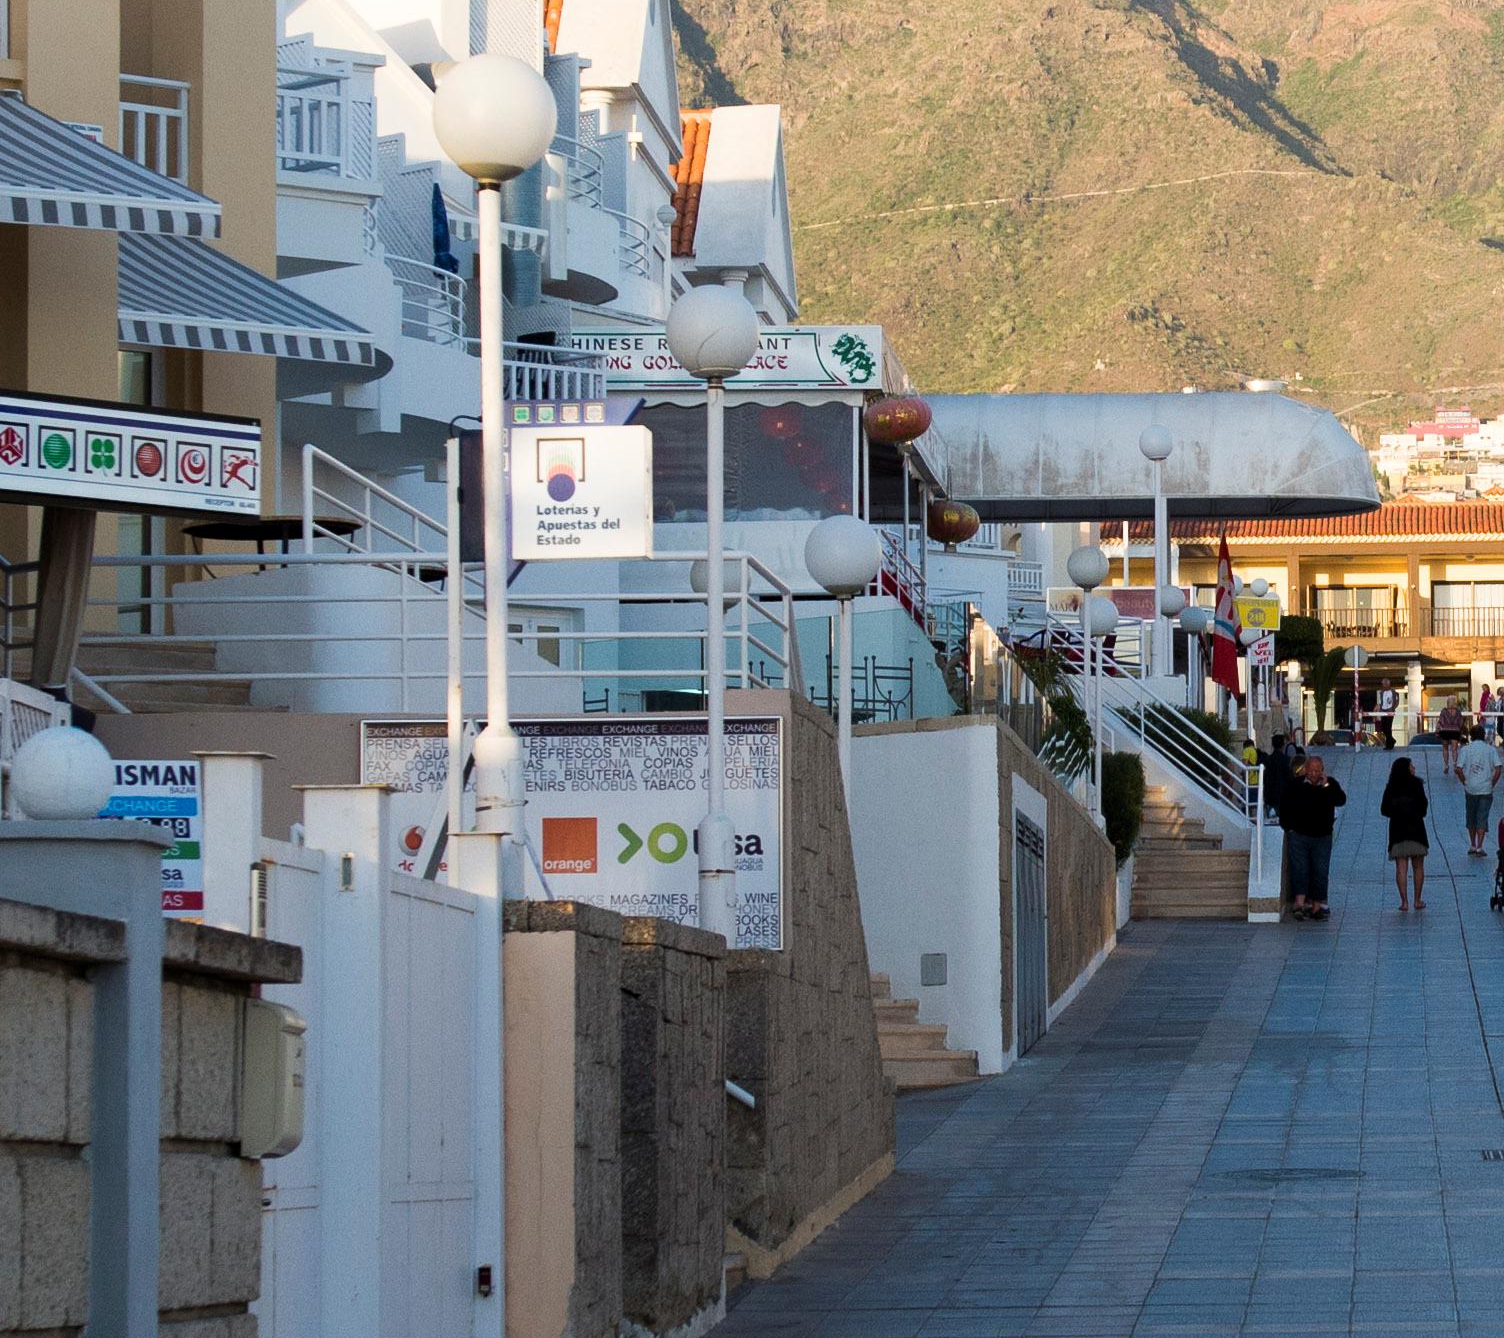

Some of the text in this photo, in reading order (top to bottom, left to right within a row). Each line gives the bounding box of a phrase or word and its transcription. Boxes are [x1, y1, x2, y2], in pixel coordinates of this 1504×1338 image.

[571, 338, 644, 351] HINESE
[593, 506, 600, 517] y
[537, 518, 620, 532] Apuestas del
[537, 534, 581, 546] Estado
[366, 727, 424, 736] EXCHANGE
[602, 725, 659, 734] EXCHANGE
[366, 739, 421, 749] PRENSA
[551, 738, 600, 748] LIBROS
[603, 736, 667, 748] REVISTAS
[670, 736, 708, 746] PREN
[727, 735, 778, 746] SELLOS
[529, 748, 612, 759] REFRESCOS
[620, 747, 650, 758] MIEL
[657, 746, 698, 758] VINOS
[749, 746, 778, 757] MIEL
[366, 757, 778, 771] FAX COPIA TELEFONIA COPIAS PELERIA
[114, 765, 196, 786] ISMAN
[366, 771, 410, 782] GAFAS
[564, 769, 634, 781] BISUTERIA
[640, 769, 693, 780] CAMBIO
[571, 781, 638, 792] BONOBUS
[644, 780, 696, 791] TABACO
[544, 861, 592, 872] orange
[610, 893, 689, 905] MAGAZINES
[745, 893, 778, 904] WINE
[737, 926, 778, 937] LASES
